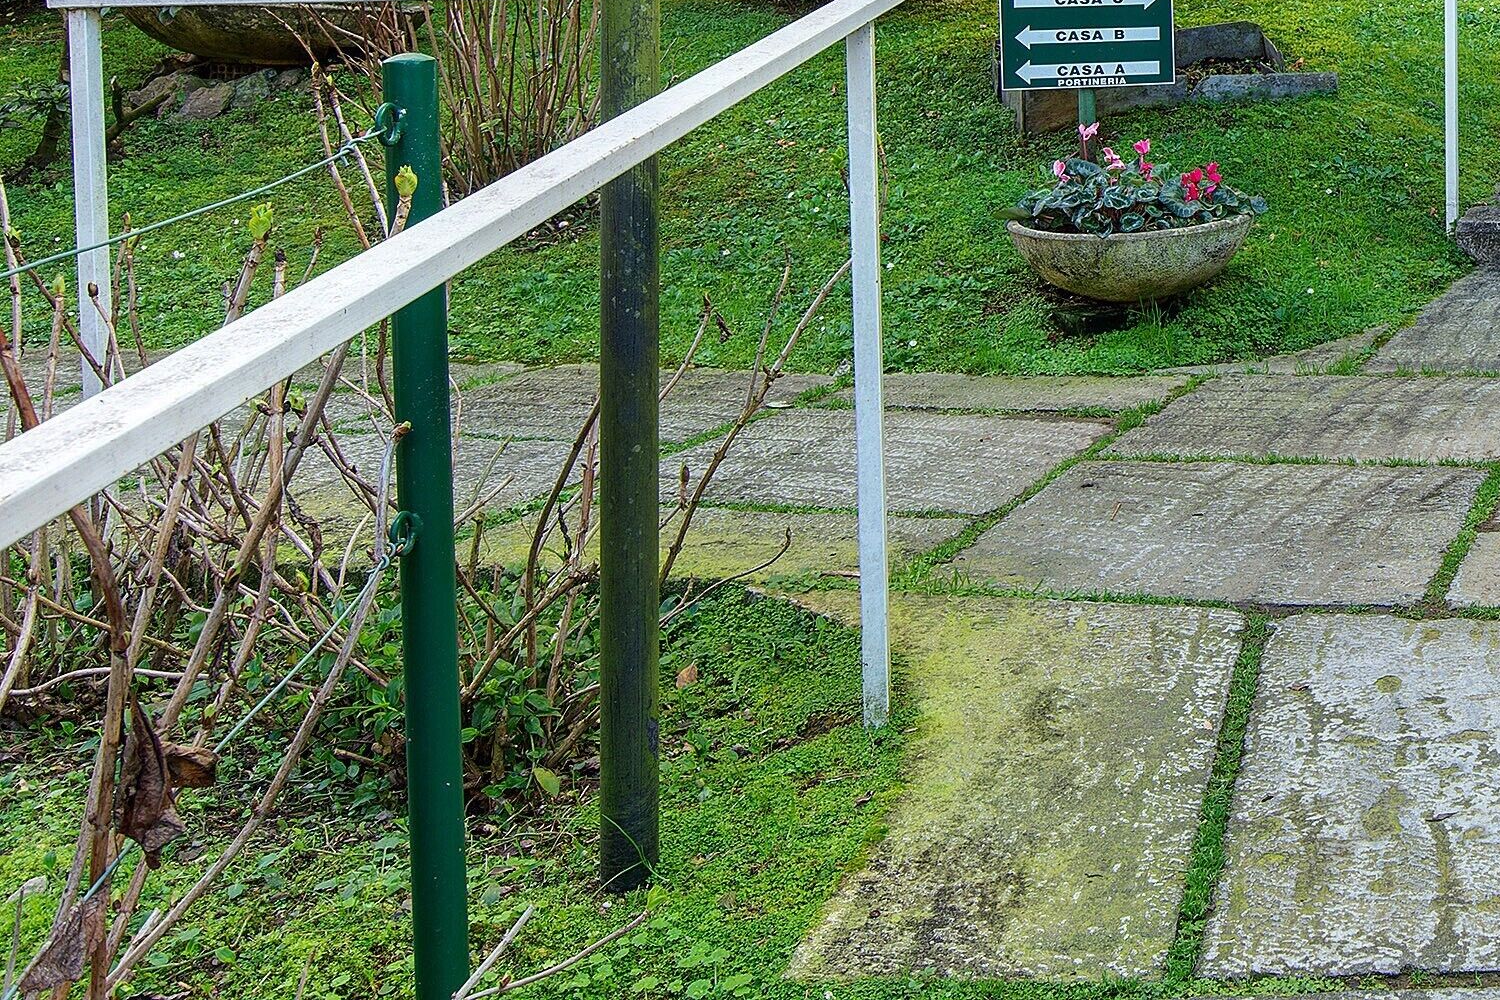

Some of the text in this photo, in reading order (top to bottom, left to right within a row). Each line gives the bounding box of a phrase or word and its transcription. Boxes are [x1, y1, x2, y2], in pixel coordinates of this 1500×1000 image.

[1055, 29, 1125, 42] CASA B
[1057, 64, 1126, 76] CASA A
[1057, 77, 1127, 87] PORTINERIA
